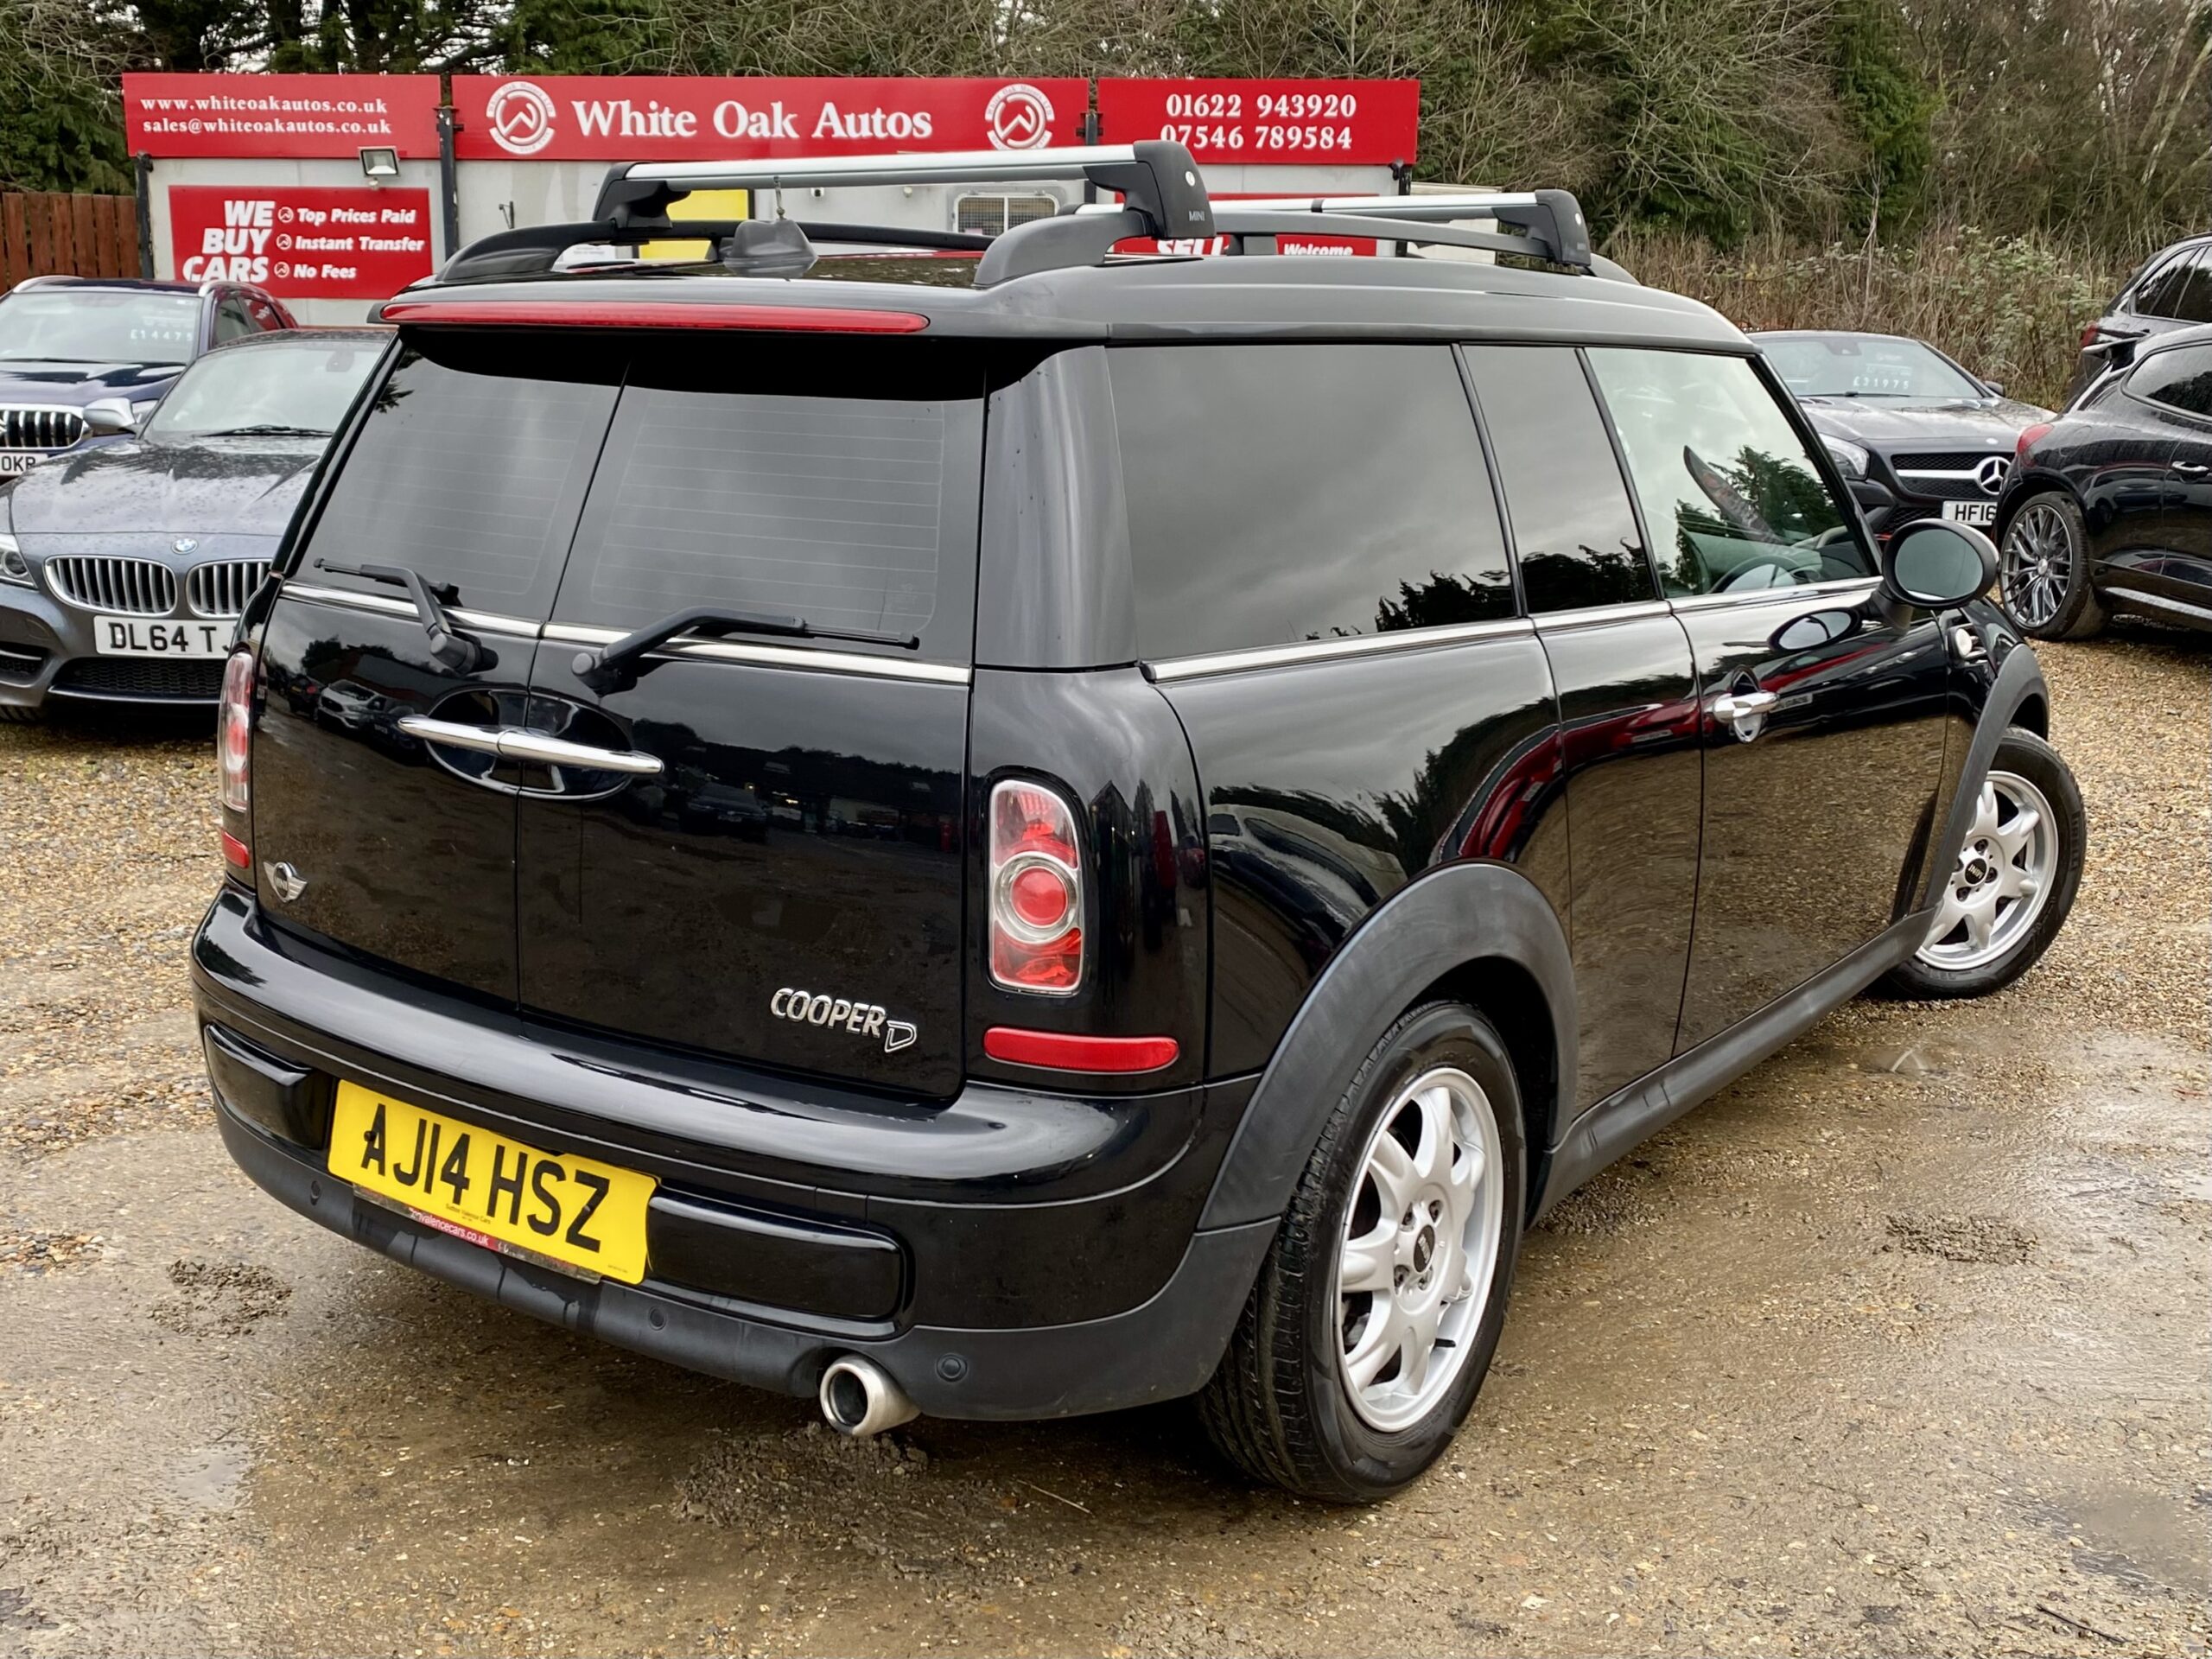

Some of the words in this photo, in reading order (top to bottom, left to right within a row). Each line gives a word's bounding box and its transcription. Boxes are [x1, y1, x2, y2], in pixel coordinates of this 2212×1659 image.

[140, 95, 388, 113] www.whiteoakautos.co.uk
[1166, 94, 1242, 118] 01622
[1256, 94, 1357, 118] 943920
[143, 118, 391, 134] sales@whiteoakautos.co.uk
[571, 100, 697, 138] White
[713, 100, 799, 138] Oak
[811, 102, 932, 139] Autos
[1160, 124, 1244, 149] 07546
[1255, 125, 1352, 149] 789584
[224, 200, 275, 226] WE
[297, 208, 326, 226] Top
[331, 208, 376, 223] Prices
[381, 209, 416, 224] Paid
[201, 228, 272, 254] BUY
[295, 235, 353, 251] Instant
[359, 236, 424, 251] Transfer
[1284, 244, 1353, 256] Welcome
[182, 257, 269, 283] CARS
[293, 264, 317, 278] No
[321, 264, 356, 279] Fees
[108, 622, 188, 652] DL64
[771, 988, 887, 1038] COOPER
[884, 1020, 918, 1053] D
[361, 1103, 470, 1205] AJ14
[486, 1145, 610, 1253] HSZ
